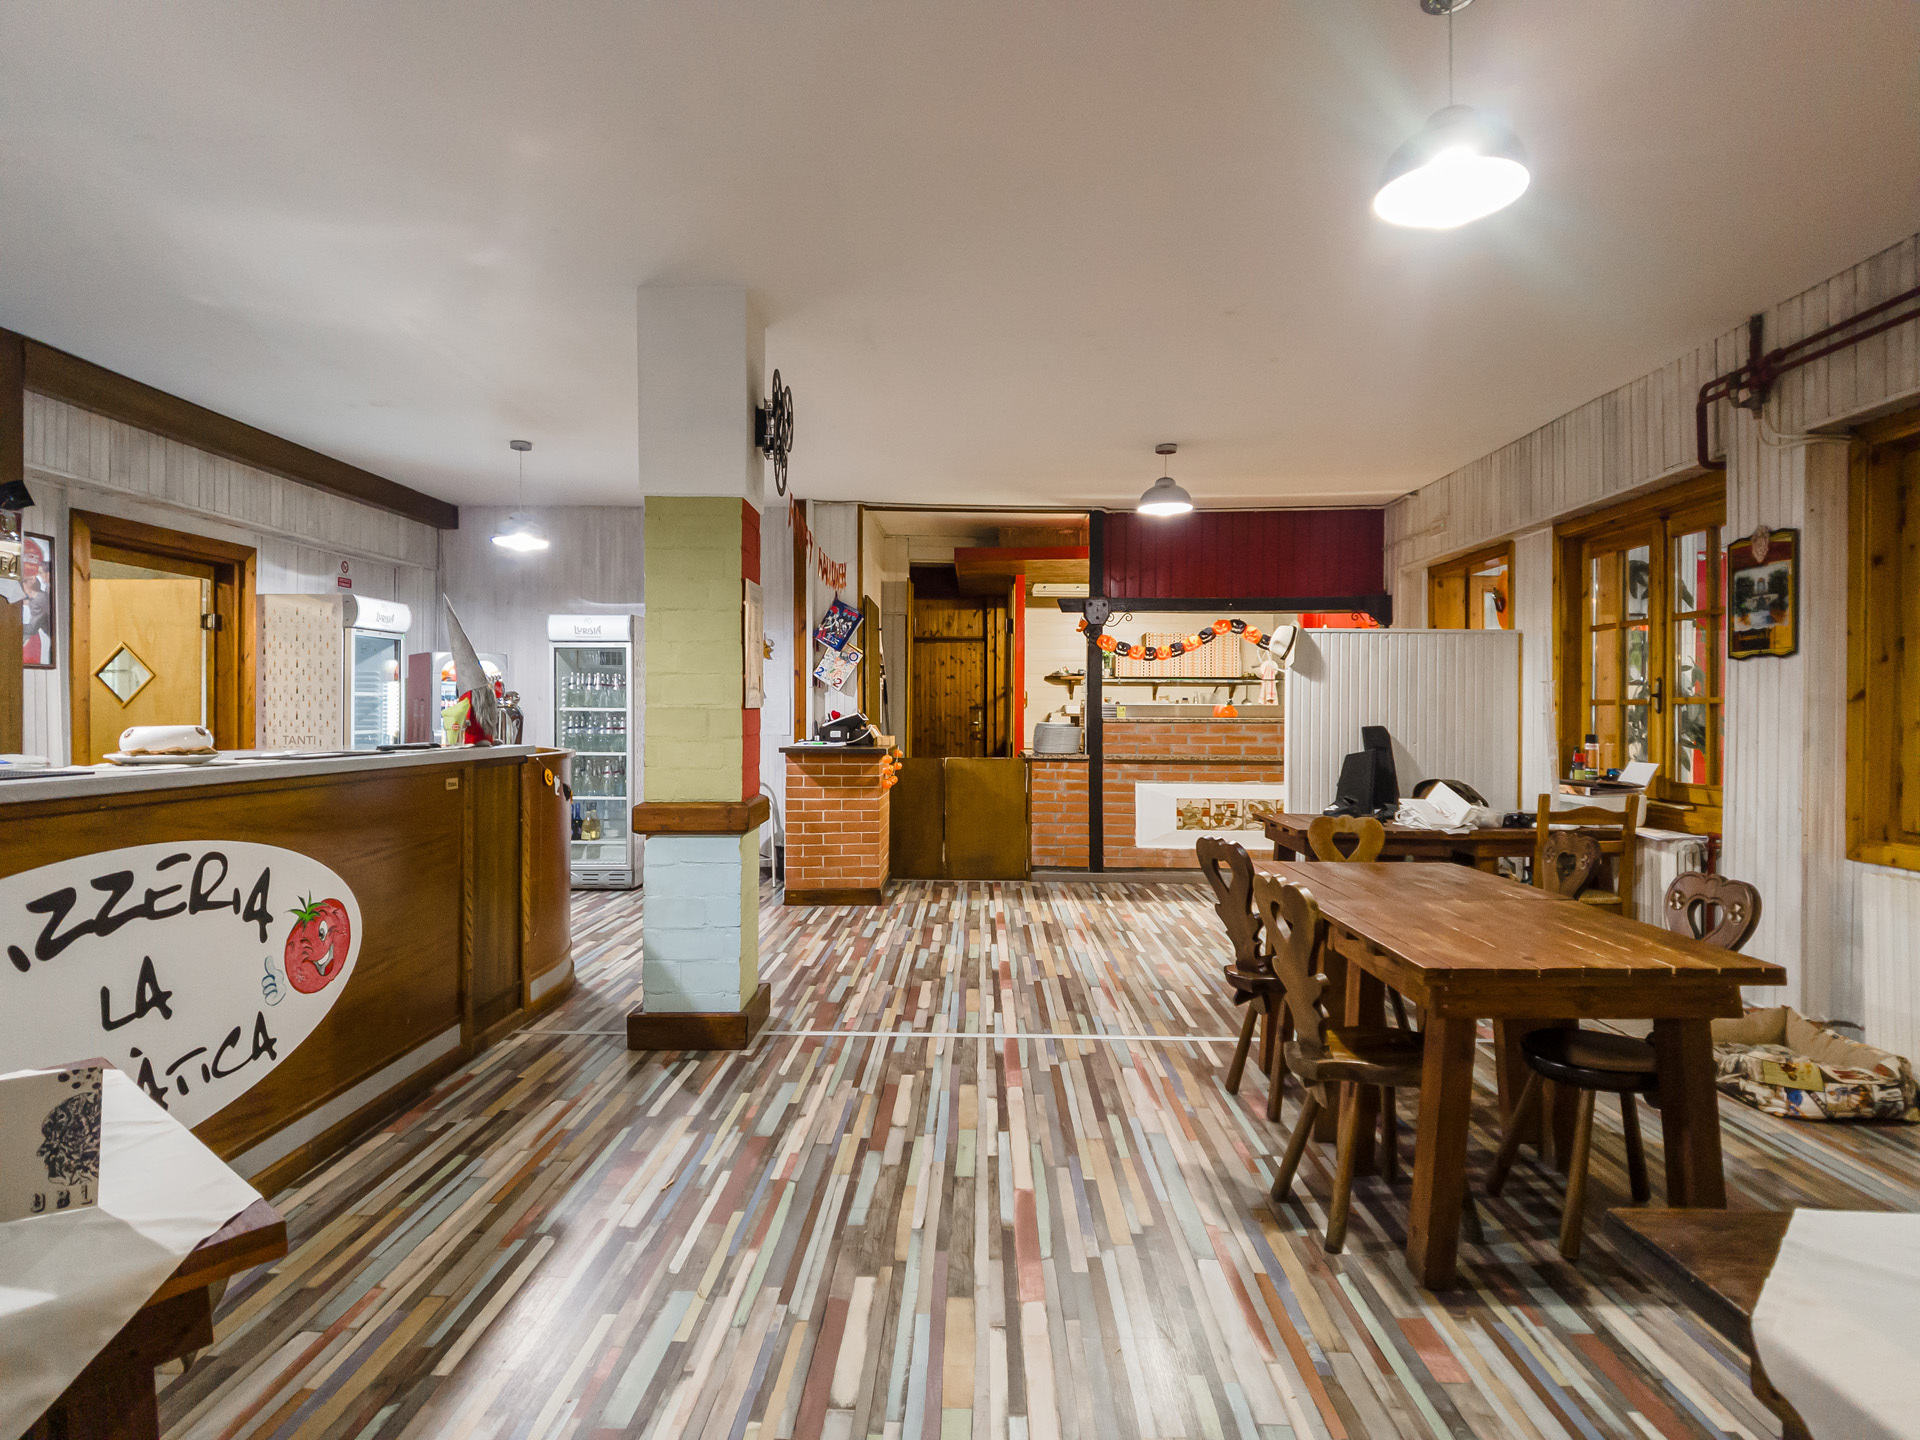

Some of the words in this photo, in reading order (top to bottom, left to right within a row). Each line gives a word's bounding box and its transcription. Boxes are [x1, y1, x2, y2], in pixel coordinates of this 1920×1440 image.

[574, 625, 602, 635] LURISIA
[282, 735, 316, 745] TANTI
[7, 851, 274, 973] IZZERIA
[101, 955, 173, 1032] LA
